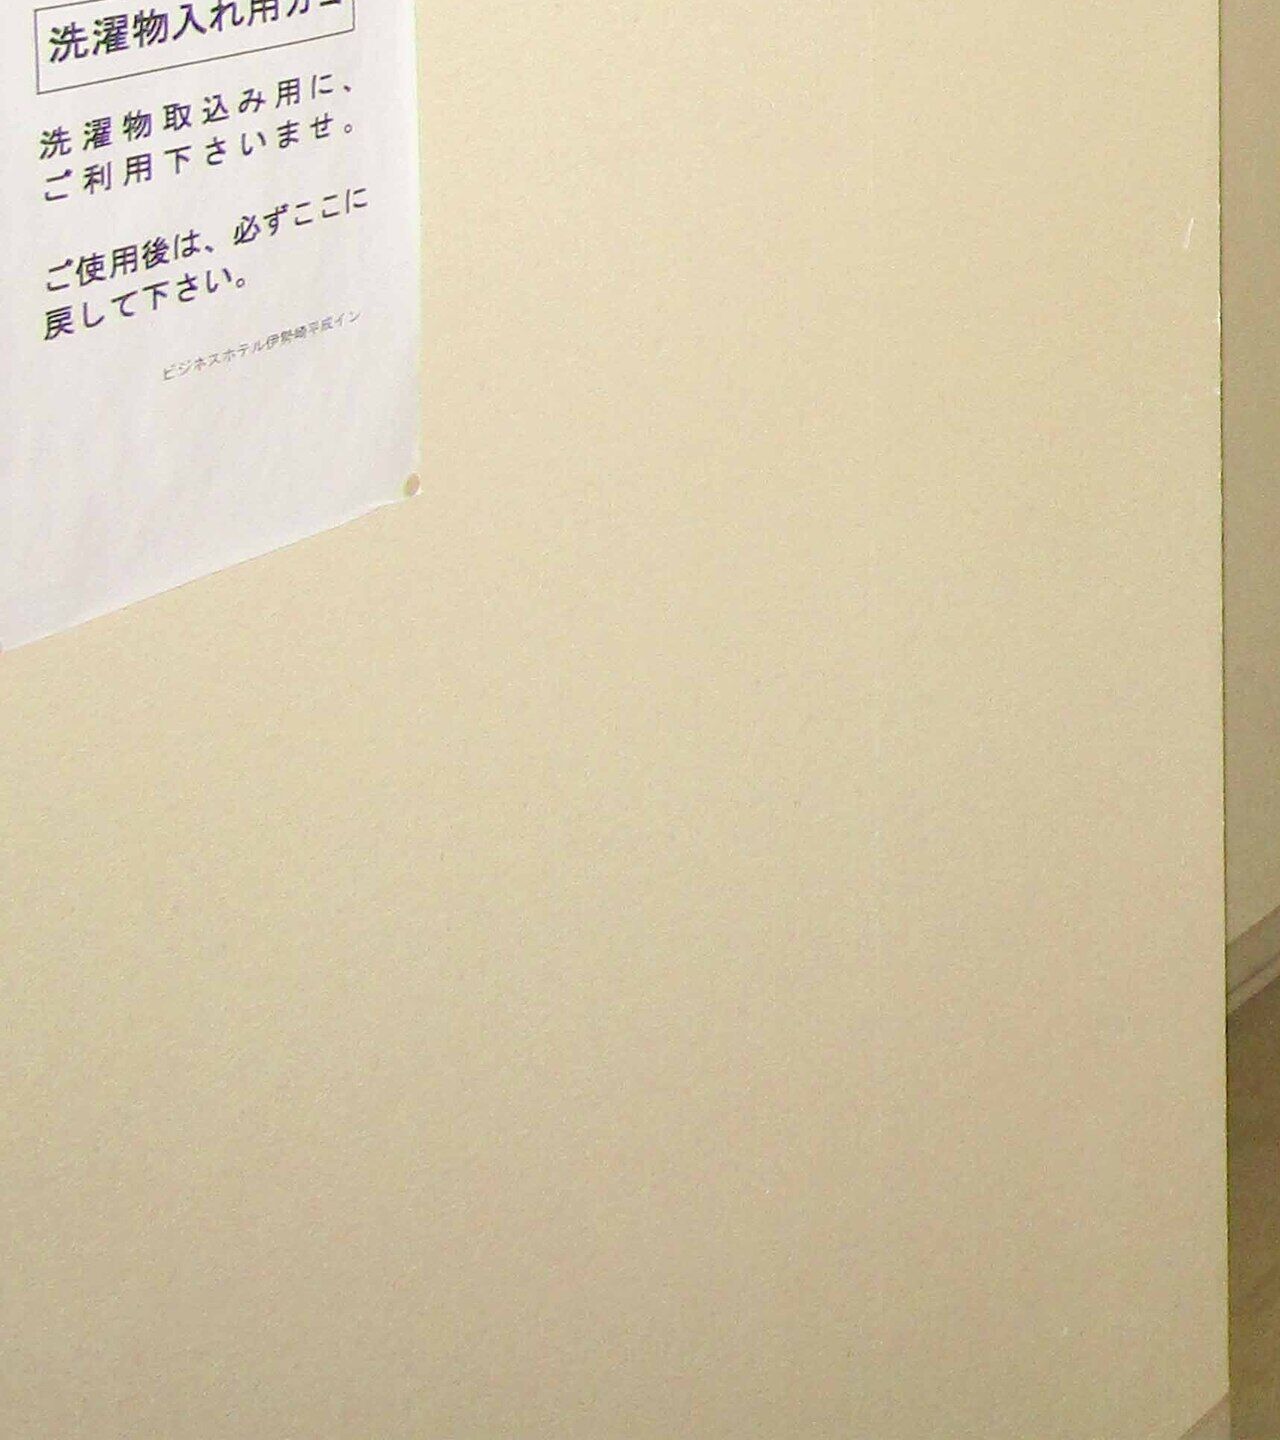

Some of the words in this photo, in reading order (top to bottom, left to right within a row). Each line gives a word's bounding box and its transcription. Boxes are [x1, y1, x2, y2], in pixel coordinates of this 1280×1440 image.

[39, 73, 356, 161] 洗濯物取込み用に、
[43, 111, 356, 204] ご利用下さいませ。
[46, 185, 370, 294] ご使用後は、必ずここに
[43, 269, 248, 342] 戻して下さい。
